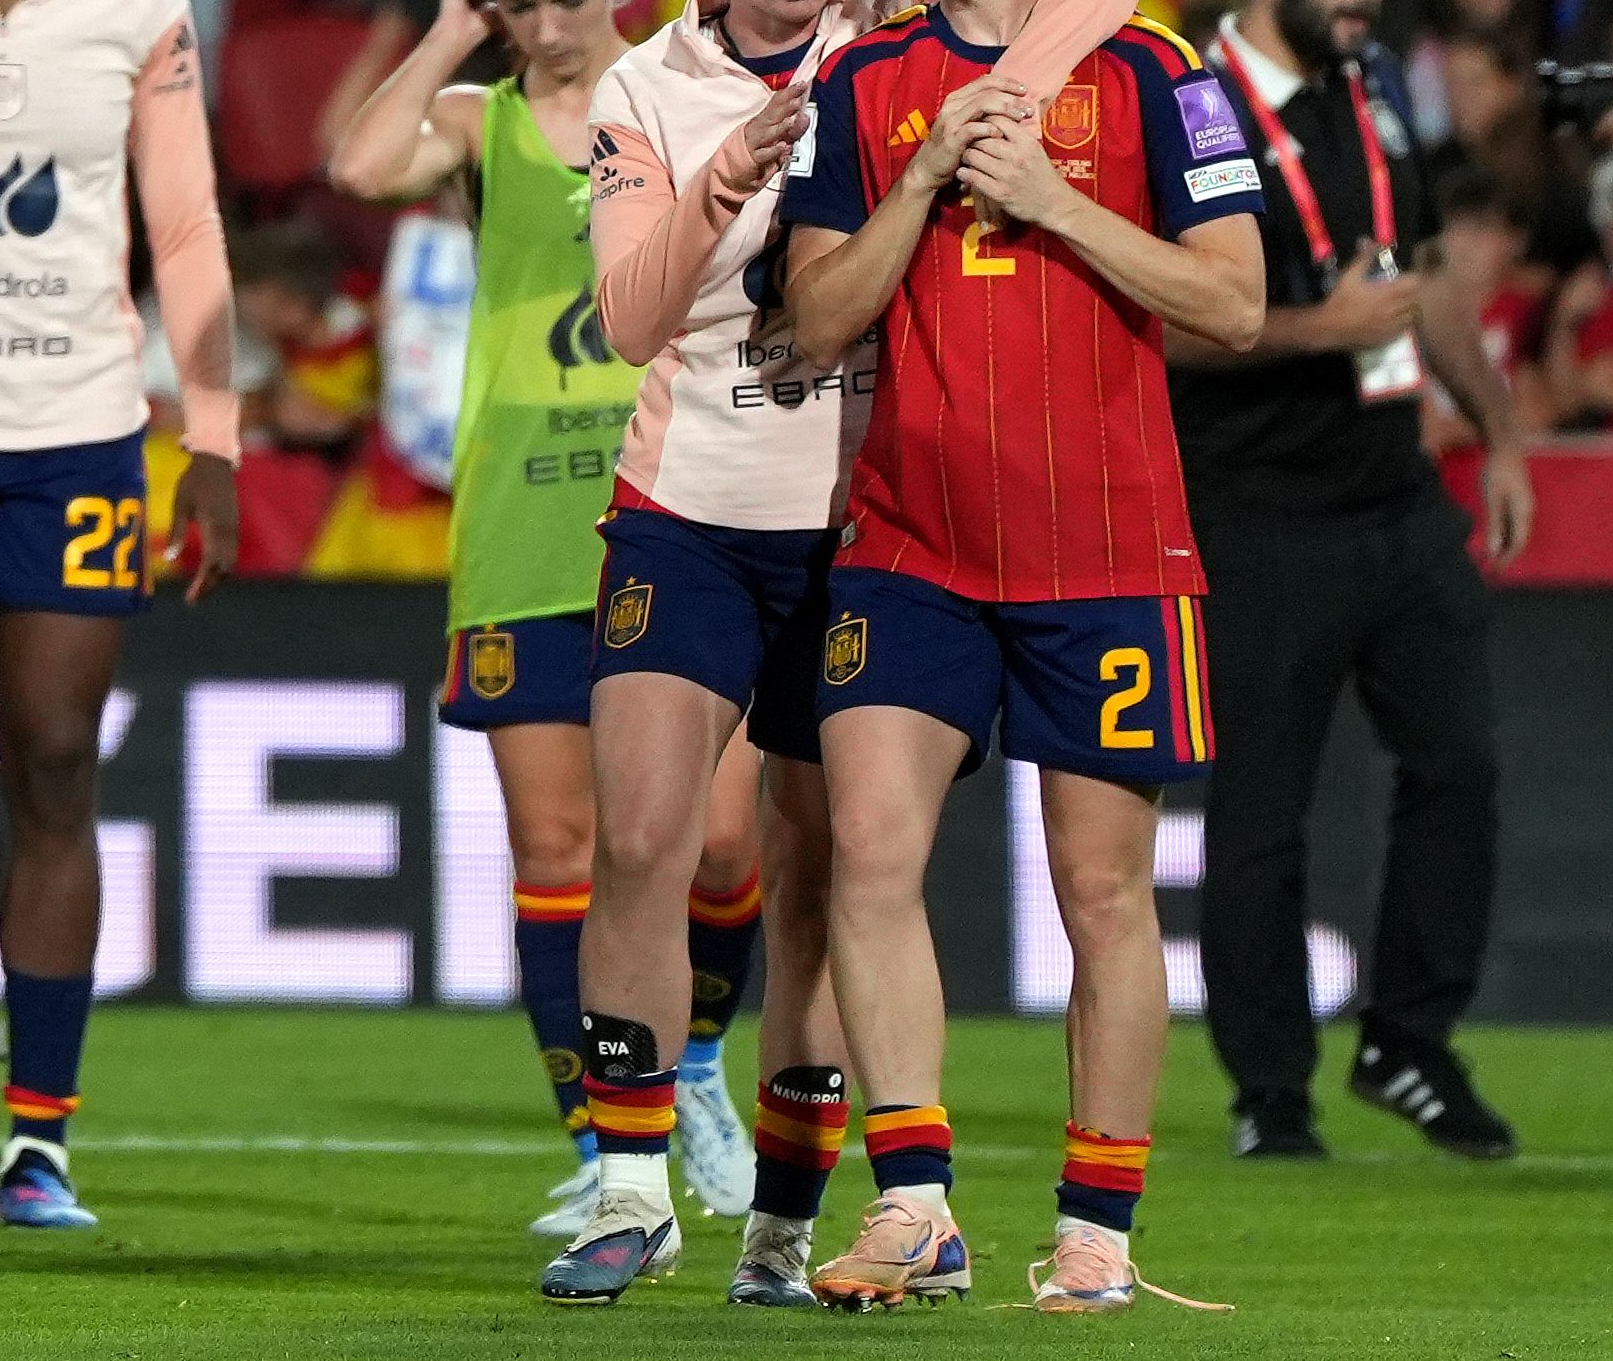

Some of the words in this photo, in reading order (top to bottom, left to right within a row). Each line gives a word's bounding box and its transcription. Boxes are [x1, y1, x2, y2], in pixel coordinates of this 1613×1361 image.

[63, 496, 142, 589] 22
[1099, 646, 1154, 750] 2
[598, 1041, 630, 1056] EVA
